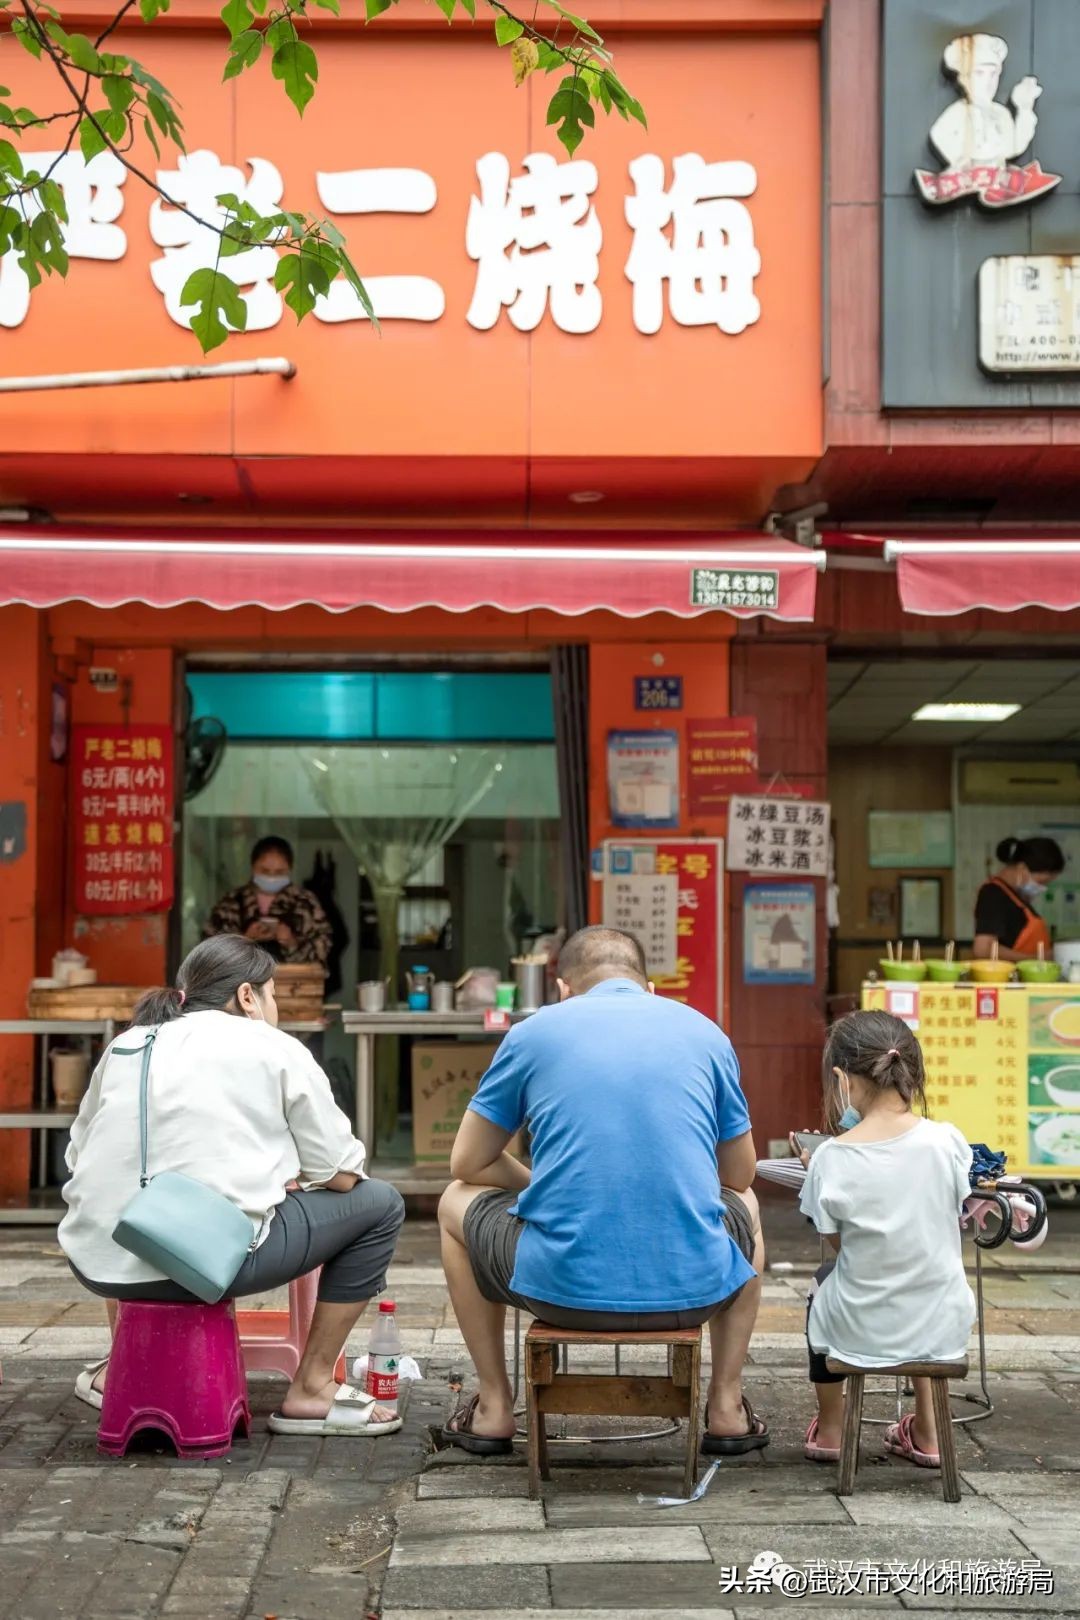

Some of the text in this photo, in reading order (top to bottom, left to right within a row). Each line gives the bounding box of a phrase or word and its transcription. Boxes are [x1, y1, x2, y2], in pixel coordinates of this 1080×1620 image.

[85, 738, 162, 760] 严老二烧梅
[82, 765, 165, 790] 6元/两(4个)
[736, 803, 825, 826] 冰绿豆汤
[746, 826, 811, 848] 冰豆浆
[745, 849, 810, 870] 冰米酒
